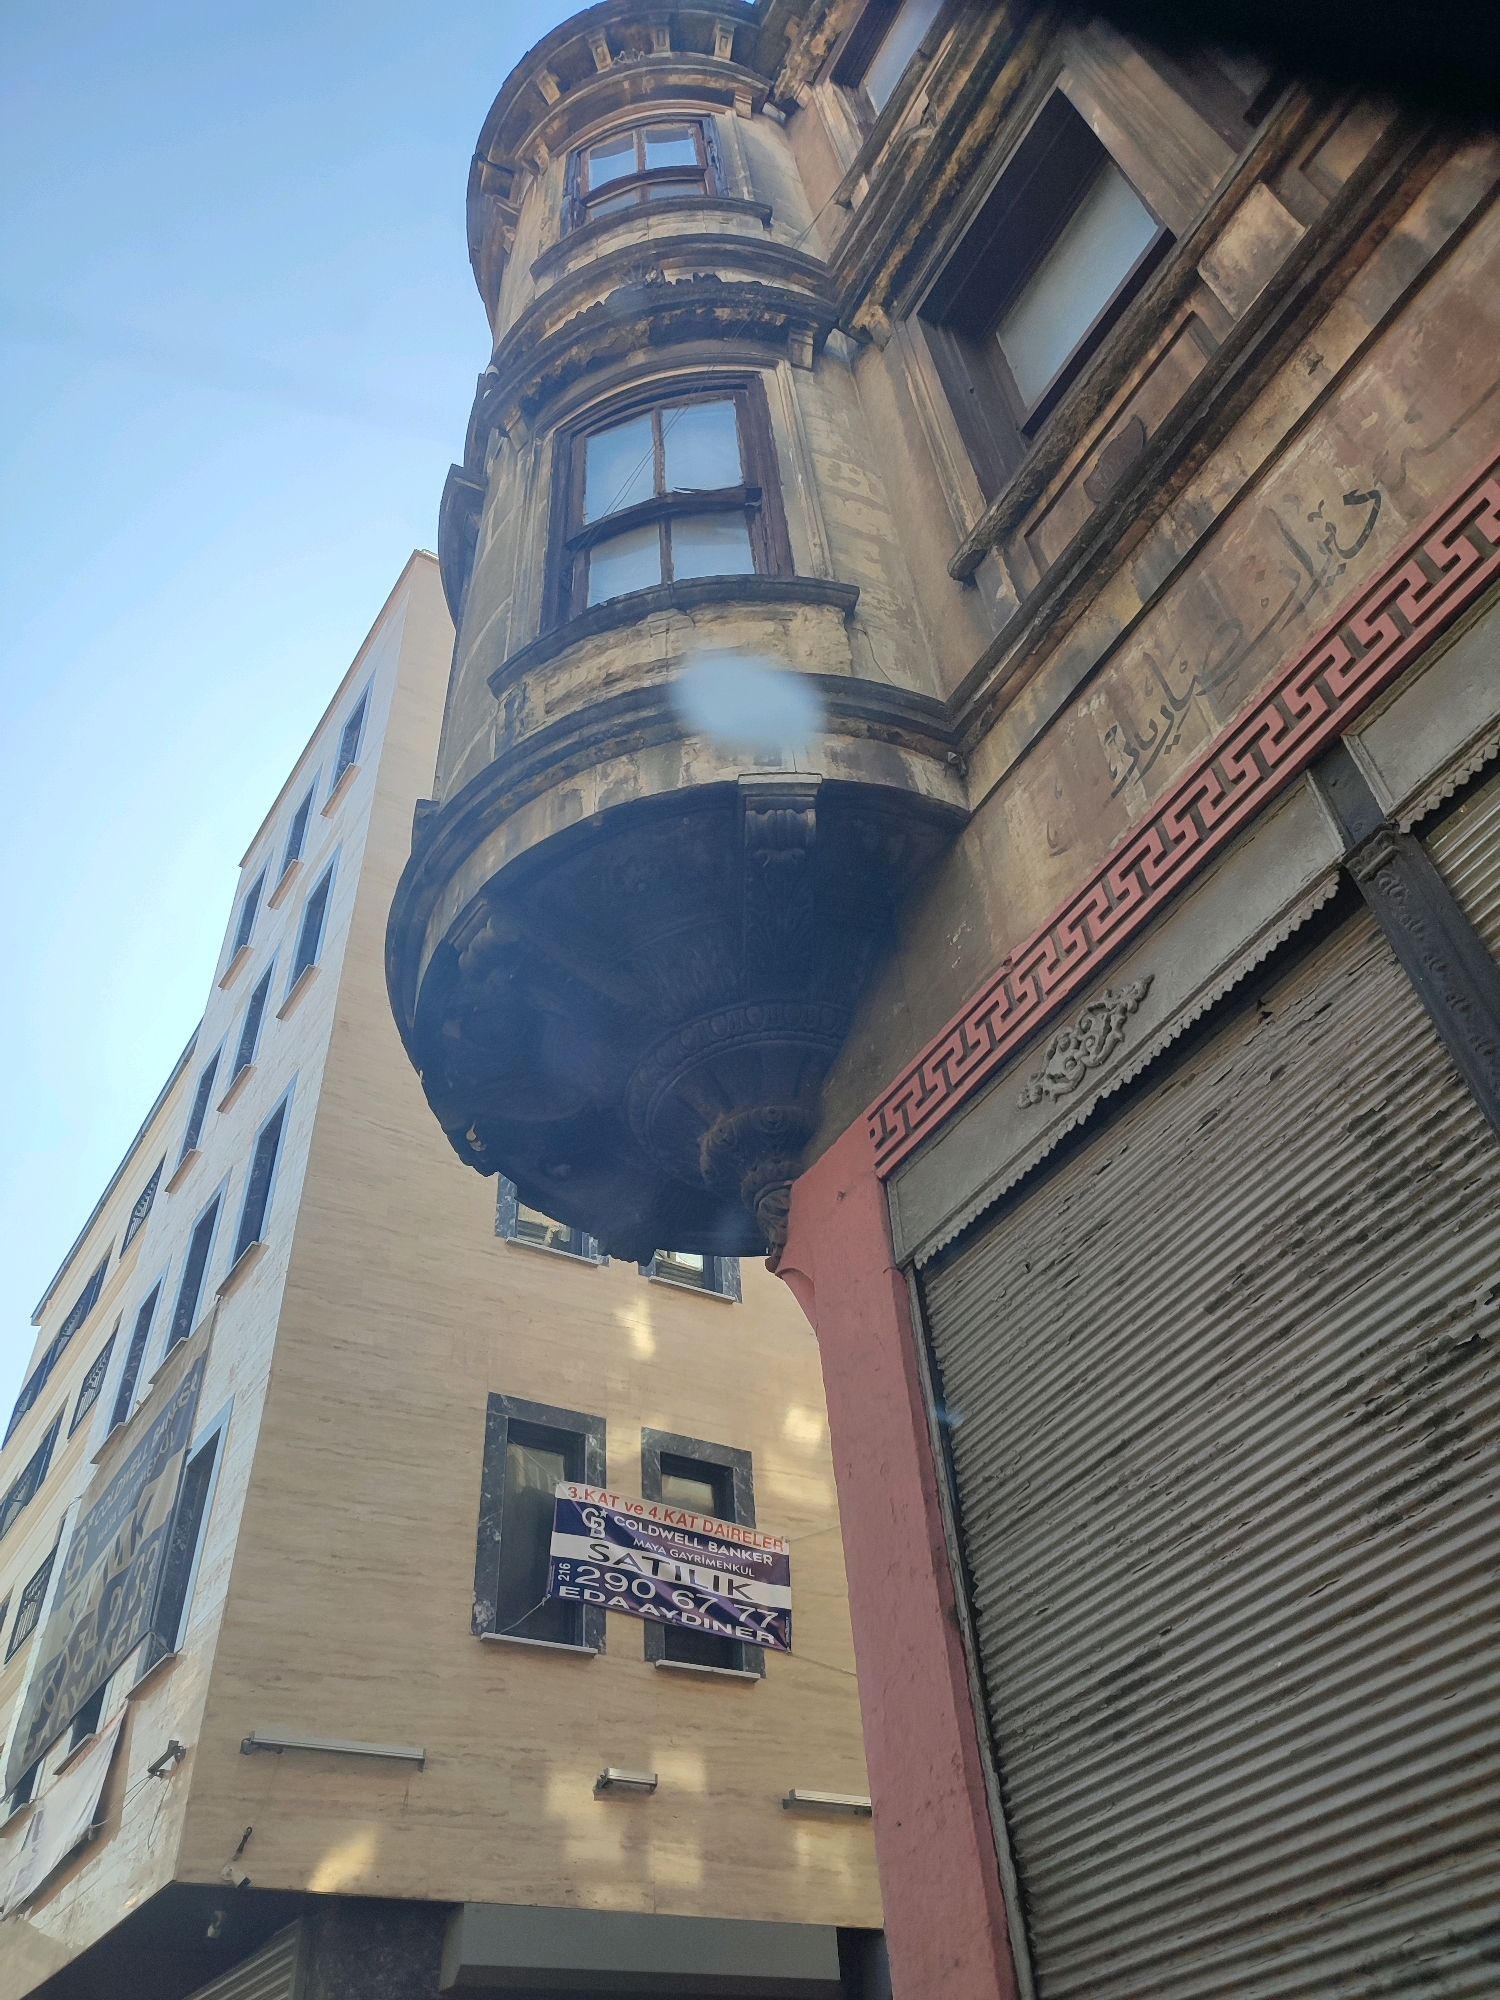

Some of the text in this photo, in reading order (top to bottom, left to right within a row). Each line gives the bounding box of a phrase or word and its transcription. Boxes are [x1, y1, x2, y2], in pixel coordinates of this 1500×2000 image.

[614, 1515, 773, 1565] COLDWELL BANKER
[625, 1502, 643, 1515] ve
[648, 1506, 698, 1529] 4.KAT
[588, 1544, 754, 1600] SATILIK
[633, 1538, 755, 1577] MAYA GAYRİMENKUL
[558, 1562, 778, 1628] 216 290 67 77
[559, 1586, 630, 1609] EDA
[639, 1603, 775, 1644] AYDINER
